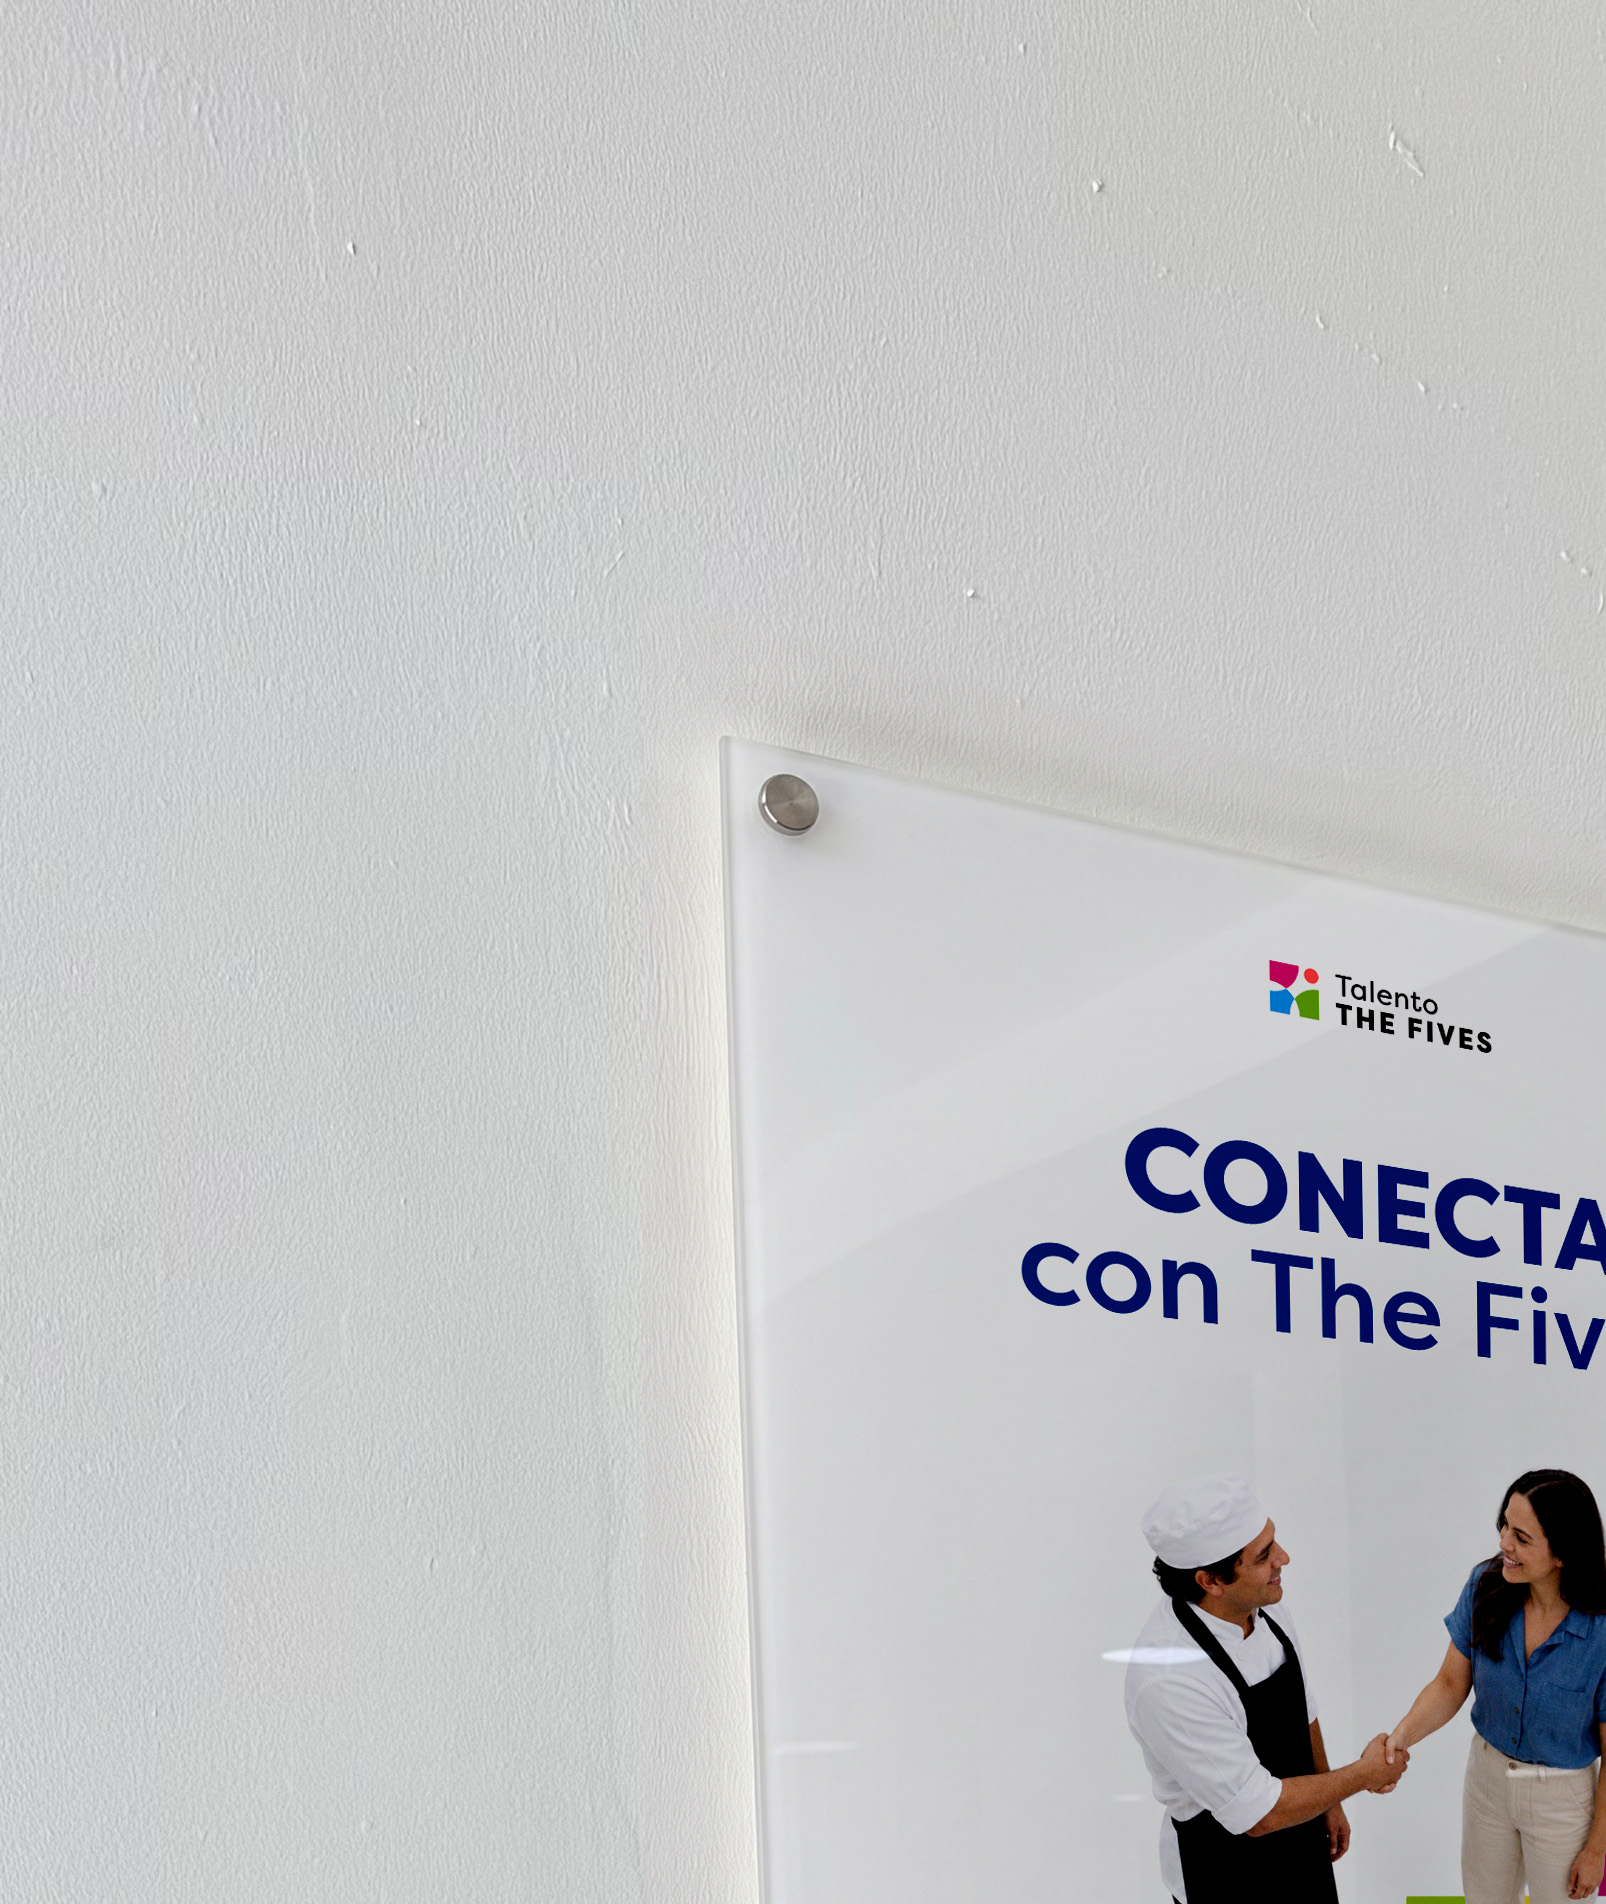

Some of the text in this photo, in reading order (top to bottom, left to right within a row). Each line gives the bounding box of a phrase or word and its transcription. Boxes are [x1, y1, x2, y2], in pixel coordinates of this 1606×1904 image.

[1335, 974, 1438, 1015] Talento
[1336, 1003, 1491, 1053] THE FIVES
[1022, 1243, 1218, 1324] con
[1251, 1249, 1440, 1350] The
